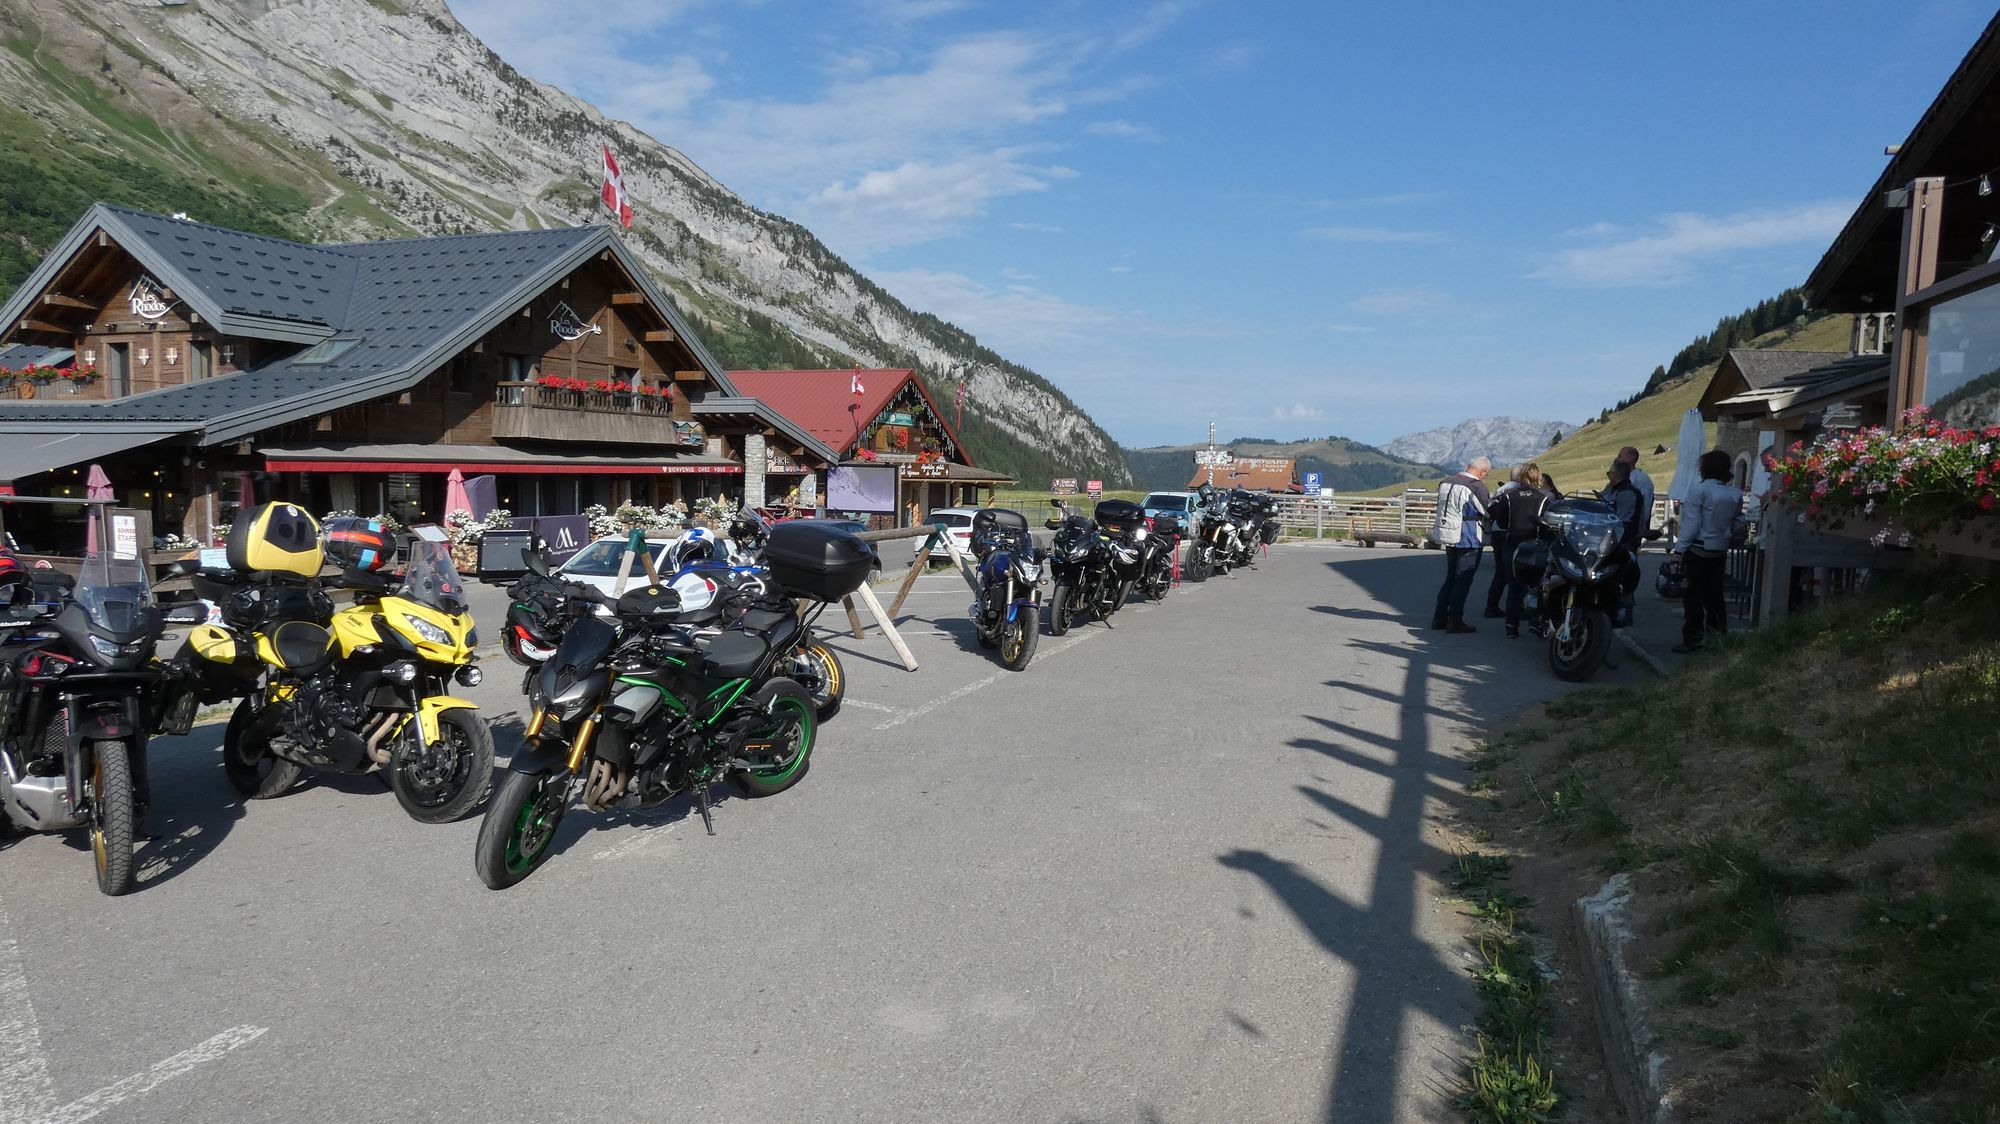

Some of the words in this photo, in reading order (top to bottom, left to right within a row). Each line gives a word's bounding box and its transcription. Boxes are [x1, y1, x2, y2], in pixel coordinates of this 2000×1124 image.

[142, 292, 155, 302] Les
[132, 298, 166, 314] Rhodos
[560, 316, 571, 325] Les
[1310, 475, 1316, 483] P
